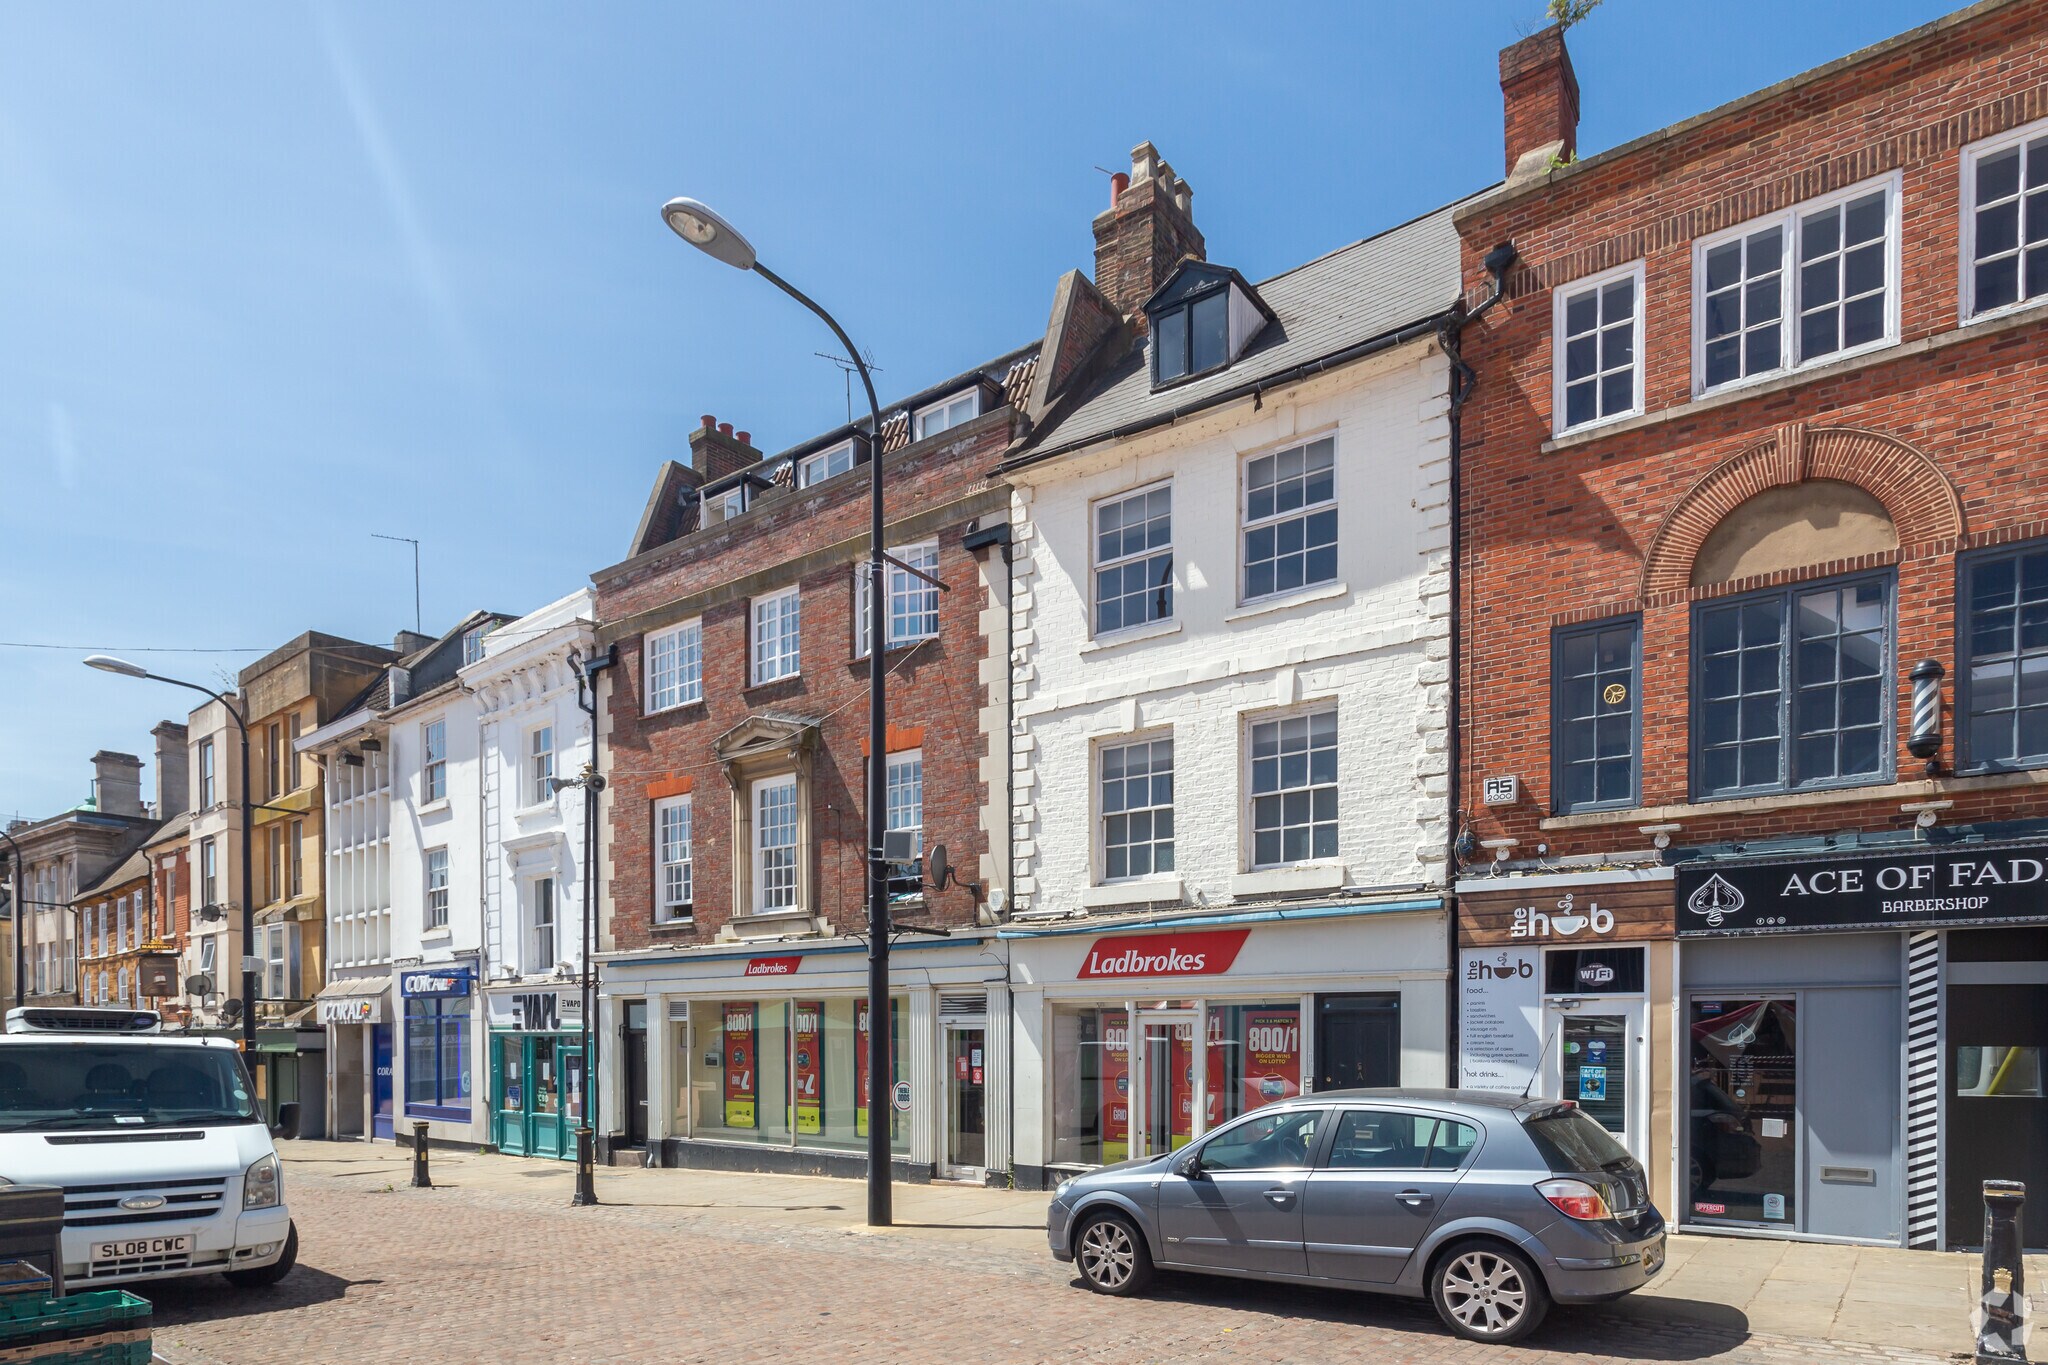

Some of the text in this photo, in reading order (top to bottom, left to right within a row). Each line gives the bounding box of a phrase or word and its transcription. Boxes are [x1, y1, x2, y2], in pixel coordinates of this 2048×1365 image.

[1488, 779, 1512, 795] AS
[1488, 793, 1512, 801] 2000
[1780, 858, 2048, 896] ACE OF FAD
[1881, 896, 1989, 913] BARBERSHOP
[1510, 907, 1528, 937] the
[748, 963, 787, 974] Ladbrokes
[1089, 948, 1206, 974] Ladbrokes
[1467, 960, 1478, 980] the
[405, 974, 450, 993] CORAL
[324, 1002, 363, 1020] CORAL
[562, 999, 581, 1007] EVAPO
[726, 1013, 752, 1031] 800/1
[1248, 1026, 1298, 1053] 800/1
[1695, 1203, 1724, 1211] UPPERCUT
[102, 1237, 185, 1258] SL08 CWC
